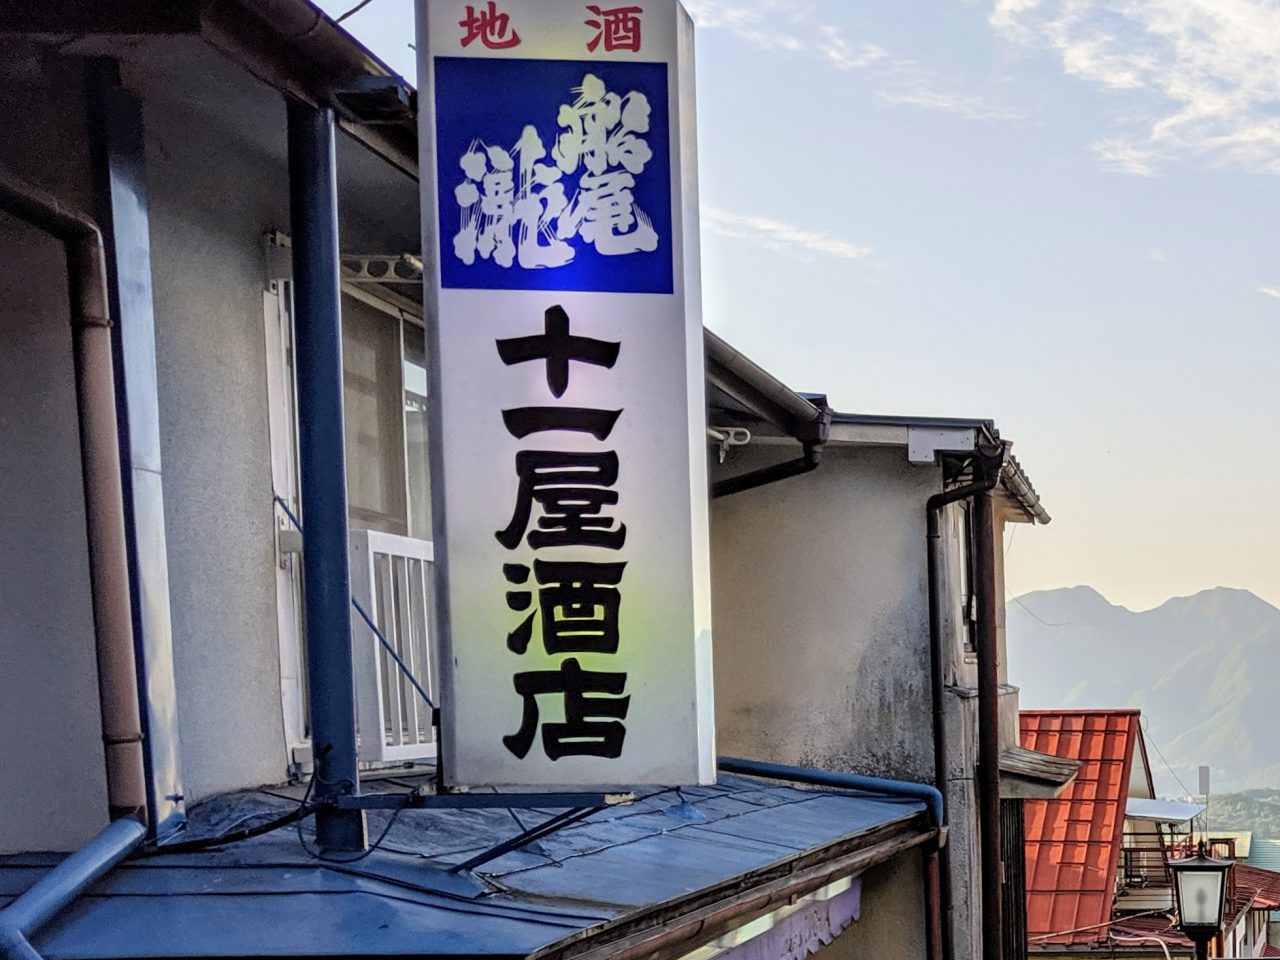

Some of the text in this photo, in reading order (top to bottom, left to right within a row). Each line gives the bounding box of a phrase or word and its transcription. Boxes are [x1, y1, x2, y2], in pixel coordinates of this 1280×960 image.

[458, 2, 644, 54] 地酒
[494, 303, 630, 762] 十一屋酒店
